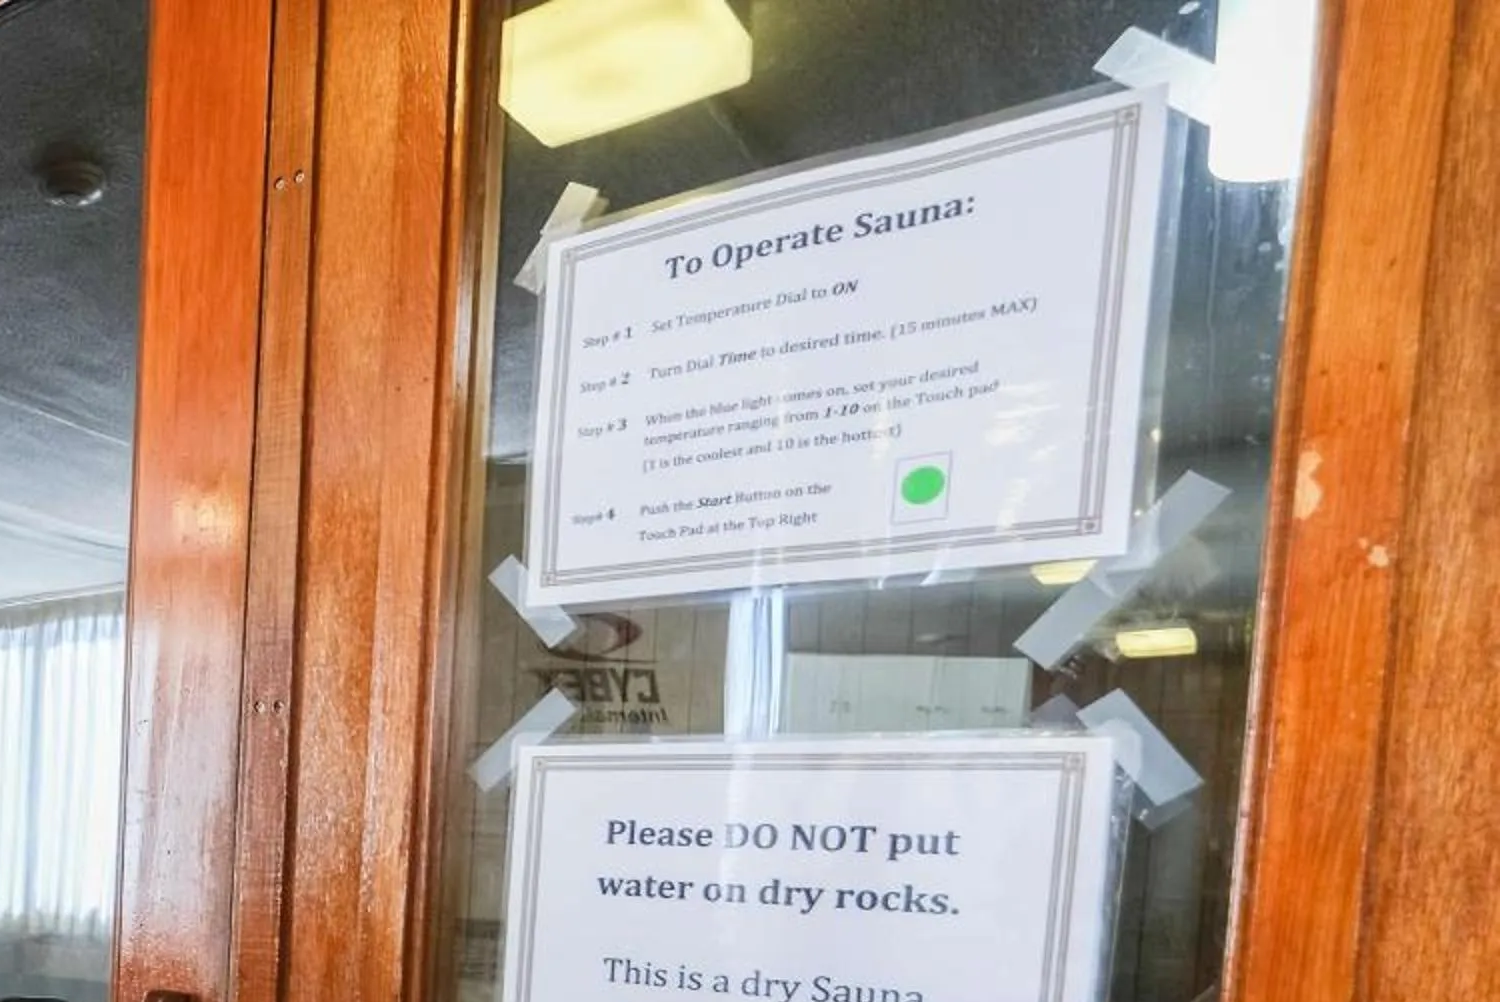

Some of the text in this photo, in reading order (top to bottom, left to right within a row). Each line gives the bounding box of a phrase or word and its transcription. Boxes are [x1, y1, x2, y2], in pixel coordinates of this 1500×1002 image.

[665, 196, 975, 279] To Operate Sauna:
[582, 334, 608, 349] Step
[625, 326, 633, 339] 1
[652, 318, 672, 333] Set
[676, 299, 772, 327] Temperature
[775, 288, 808, 307] Dial
[811, 288, 827, 299] to
[832, 279, 859, 296] ON
[580, 379, 606, 394] Step
[621, 372, 631, 385] 2
[650, 364, 682, 380] Turn
[687, 358, 715, 373] Dial
[719, 349, 756, 366] Time
[761, 346, 775, 358] to
[779, 333, 839, 354] desired
[845, 329, 885, 346] time.
[890, 321, 917, 340] (15
[921, 309, 985, 331] minutes
[991, 297, 1038, 317] MAX)
[577, 426, 602, 439] Step
[616, 418, 628, 432] 3
[645, 413, 682, 427] When
[685, 407, 706, 419] the
[710, 399, 739, 415] blue
[741, 394, 772, 410] light
[853, 381, 875, 393] set
[878, 375, 916, 393] your
[920, 361, 979, 383] desired
[644, 379, 999, 446] temperature ranging from 1-10 on the Touch pad
[660, 459, 670, 469] is
[673, 455, 693, 466] the
[696, 446, 743, 463] coolest
[746, 441, 772, 455] and
[778, 437, 794, 451] 10
[798, 438, 810, 448] is
[814, 433, 837, 446] the
[640, 504, 669, 516] Push
[674, 500, 693, 511] the
[696, 495, 732, 508] Start
[735, 490, 781, 504] Button
[785, 486, 803, 497] on
[807, 483, 832, 495] the
[639, 512, 818, 541] Touch Pad at the Top Right
[606, 819, 961, 862] Please DO NOT put
[597, 874, 960, 915] water on dry rocks.
[603, 957, 668, 989] This
[677, 964, 702, 991] is
[712, 974, 730, 994] a
